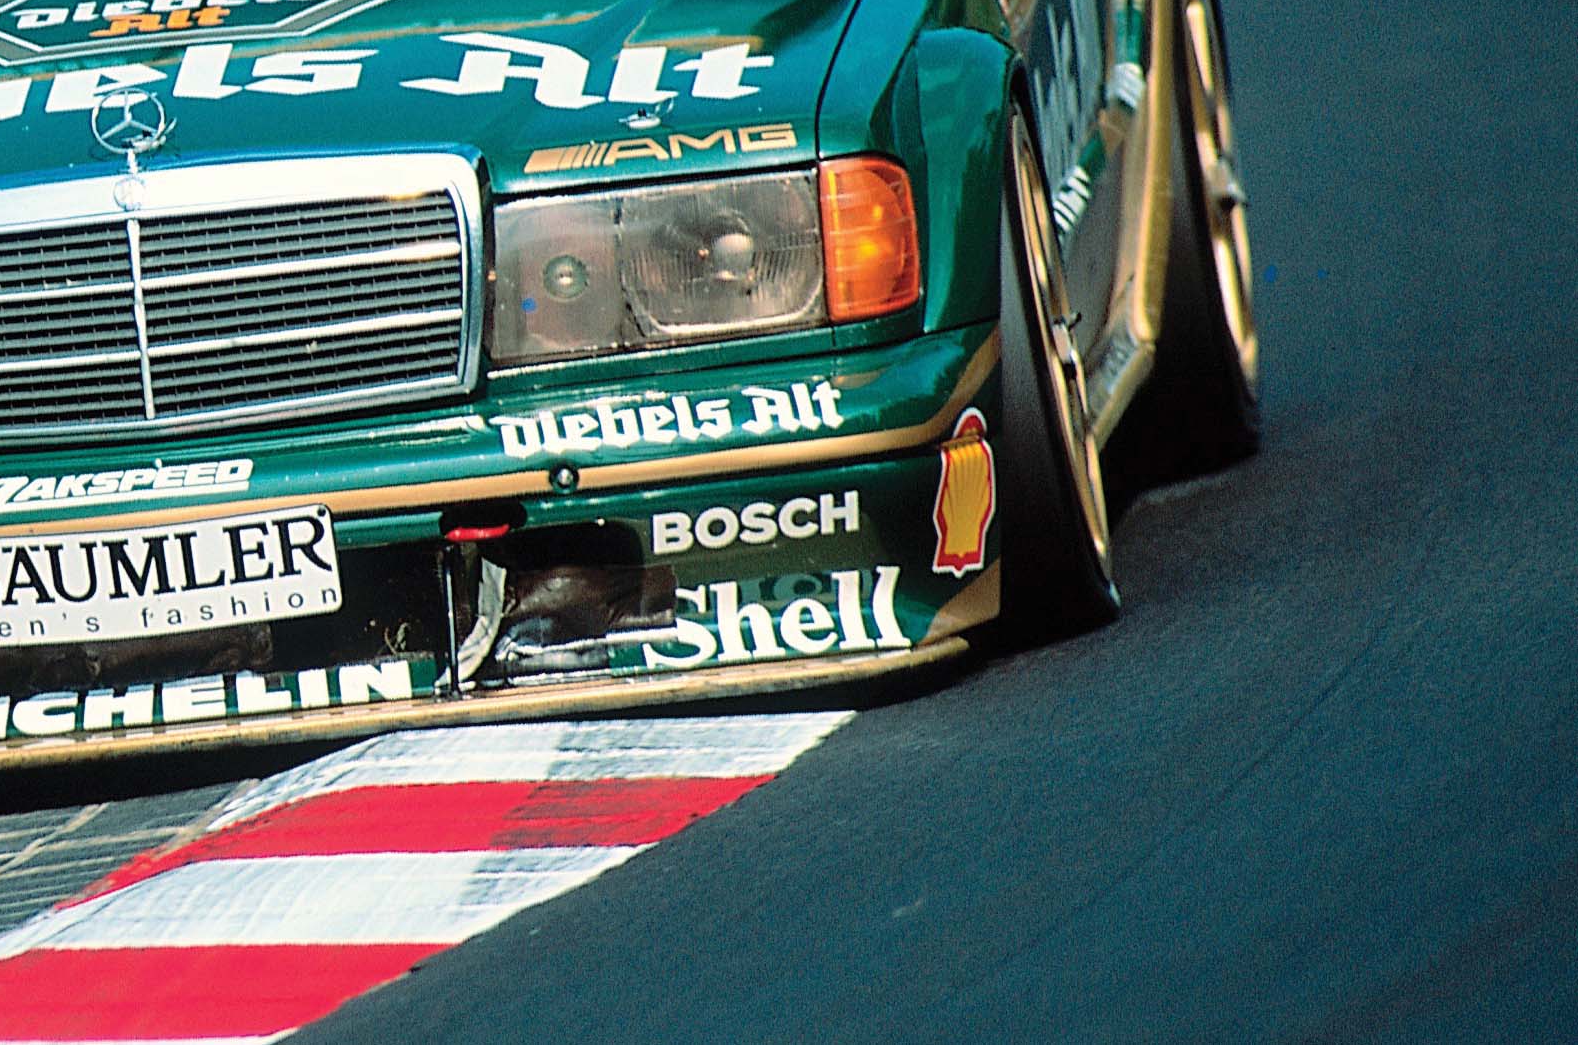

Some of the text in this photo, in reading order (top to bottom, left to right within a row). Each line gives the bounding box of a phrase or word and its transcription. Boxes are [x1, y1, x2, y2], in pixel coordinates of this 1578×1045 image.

[89, 6, 231, 37] Alt
[398, 32, 775, 109] Alt
[603, 122, 798, 166] AMG
[489, 380, 844, 459] Diebels Alt
[652, 489, 861, 555] BOSCH
[141, 586, 339, 628] fashion
[642, 565, 912, 670] Shell
